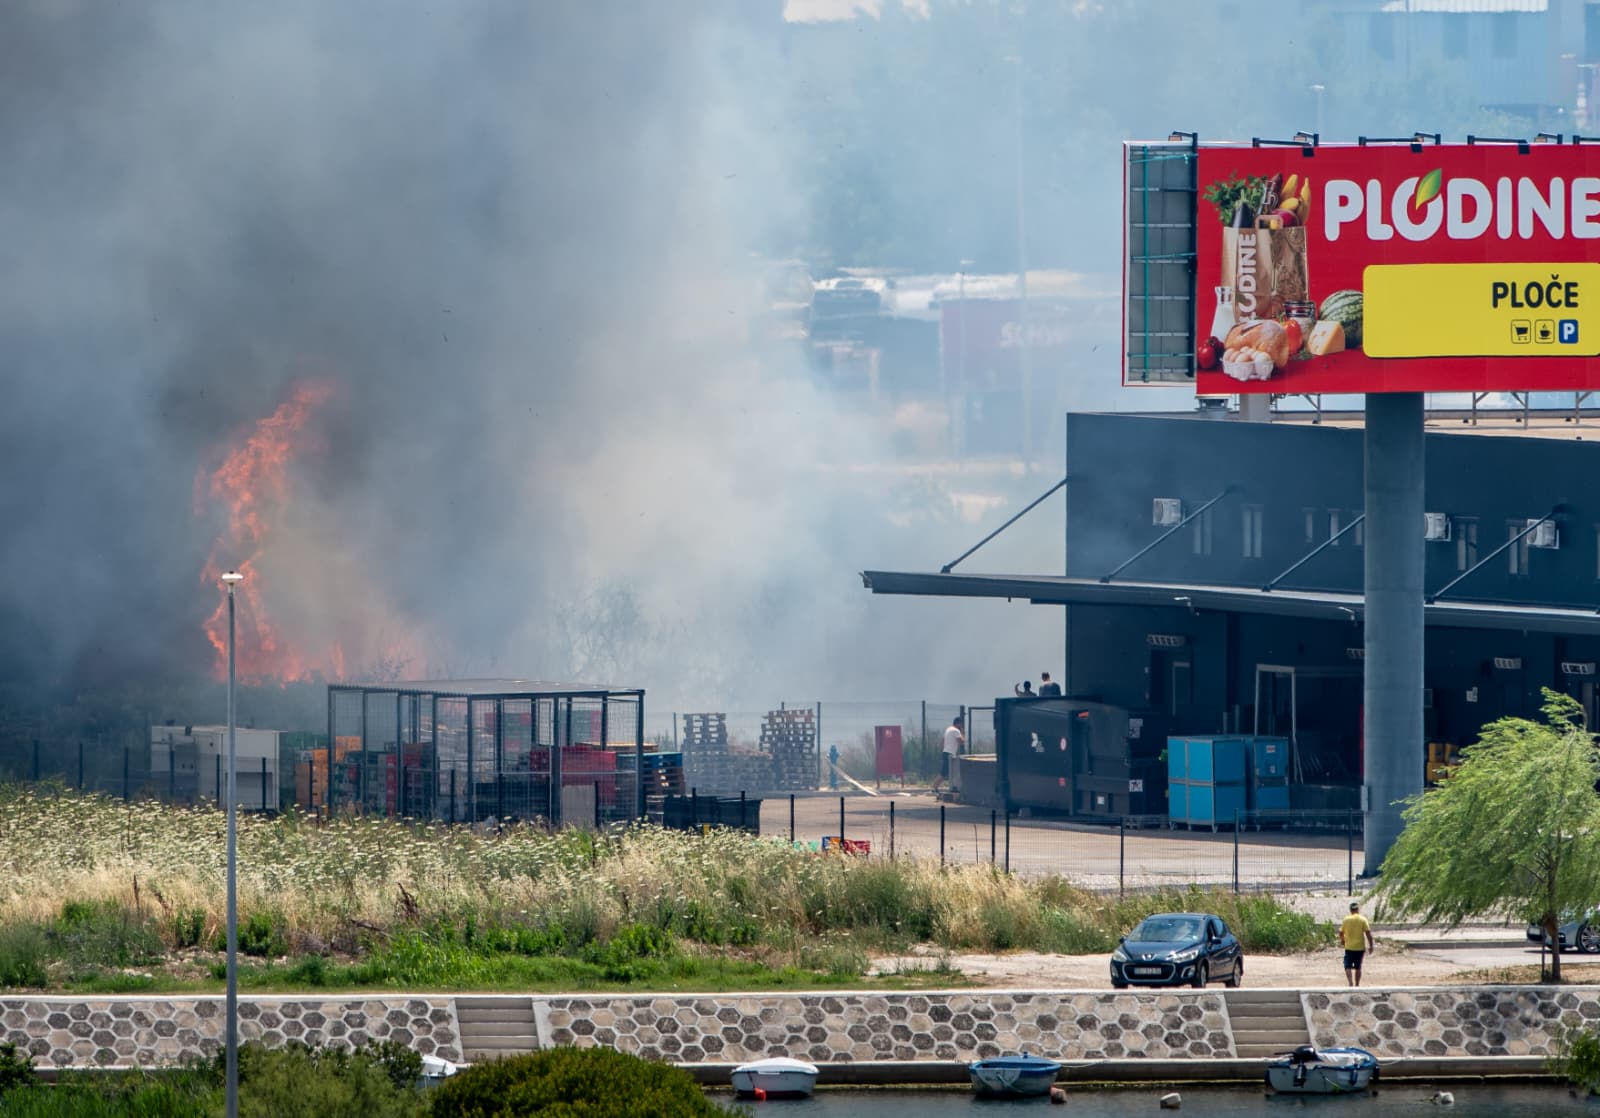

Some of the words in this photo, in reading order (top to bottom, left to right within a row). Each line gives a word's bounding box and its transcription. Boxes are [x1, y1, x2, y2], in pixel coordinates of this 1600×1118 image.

[1324, 176, 1600, 241] PLODINE
[1239, 233, 1257, 323] LODINE
[1492, 273, 1579, 308] PLOČE
[1563, 322, 1575, 341] P
